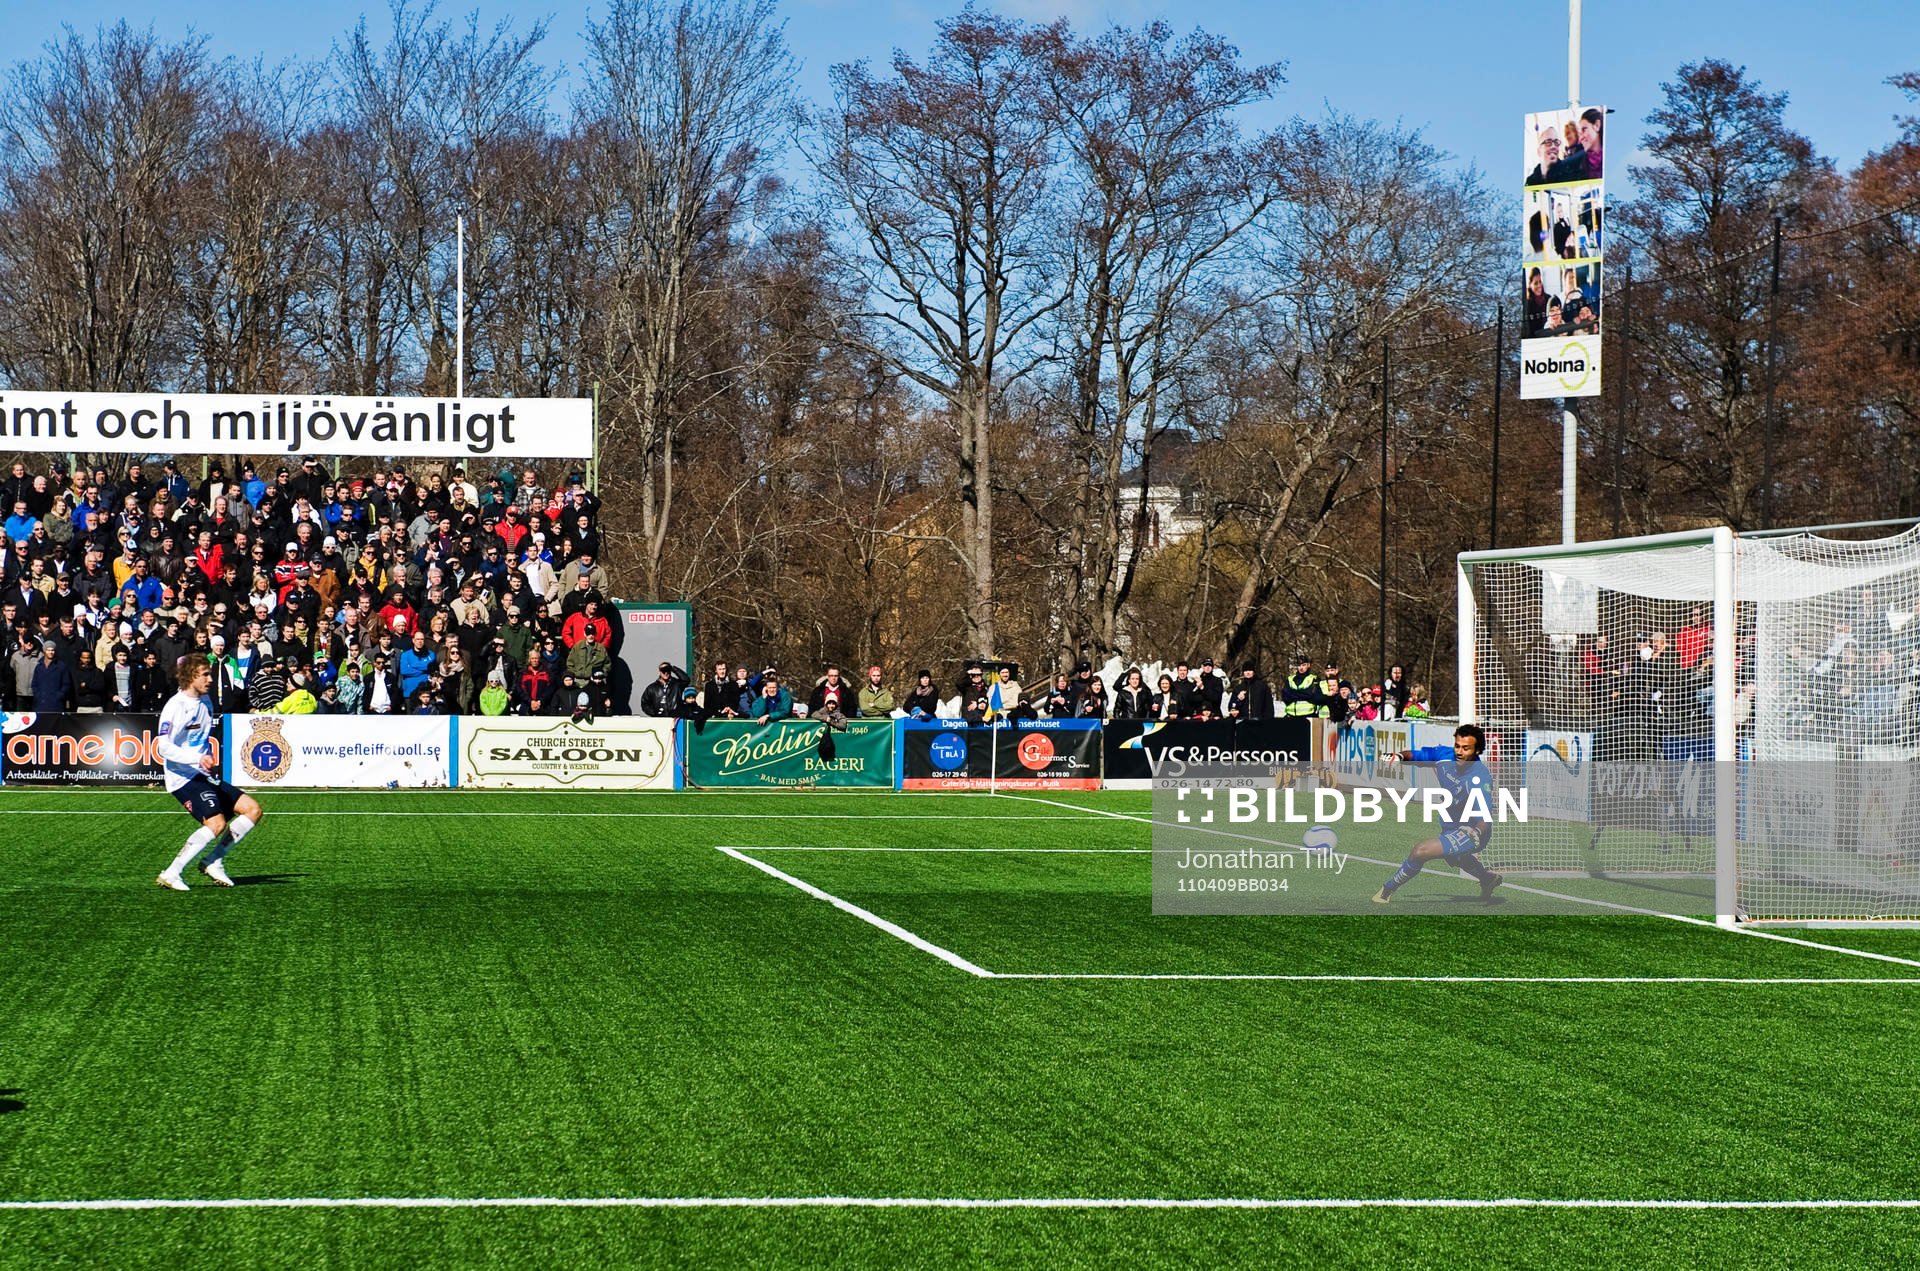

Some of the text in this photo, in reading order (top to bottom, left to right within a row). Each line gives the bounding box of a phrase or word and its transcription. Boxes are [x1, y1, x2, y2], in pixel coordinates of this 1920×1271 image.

[96, 400, 191, 440] och
[212, 400, 515, 452] miljövänligt
[852, 726, 868, 735] 1946
[527, 738, 605, 747] CHURCH STREET
[713, 725, 826, 768] Bodins
[7, 735, 104, 765] arne
[490, 748, 642, 762] SALOON
[1024, 745, 1067, 762] Gourmet
[804, 758, 864, 772] BAGERI
[976, 780, 1037, 788] Matlgningskurser
[1161, 779, 1211, 788] 026-14
[1236, 779, 1254, 787] 80
